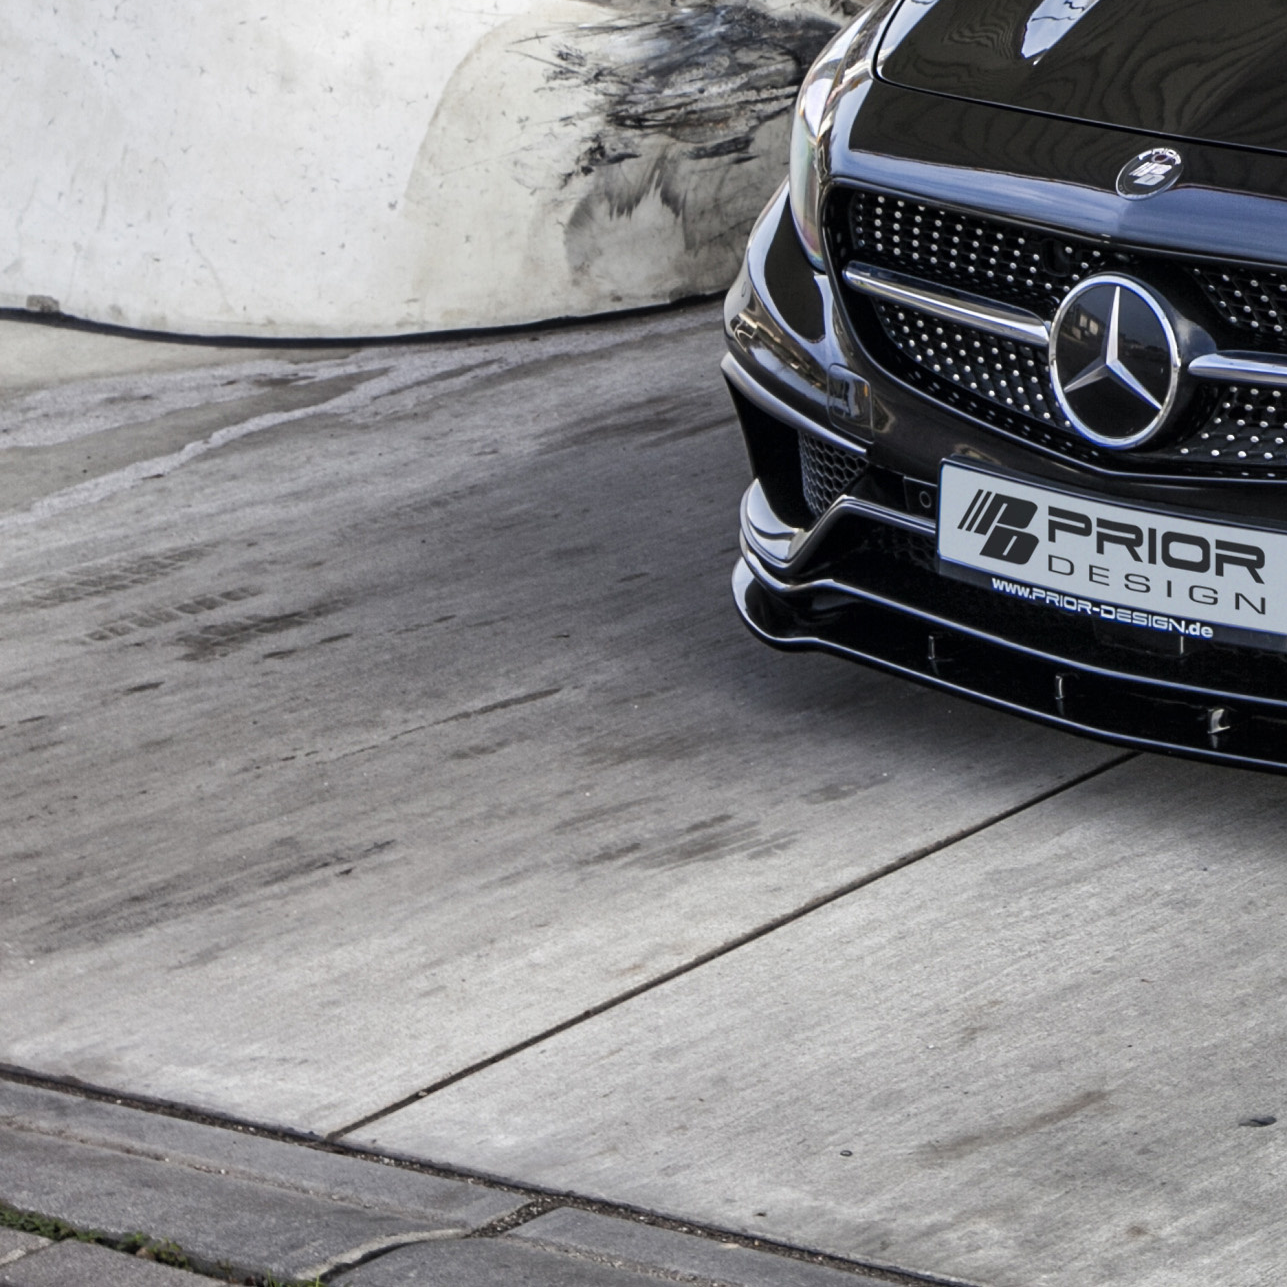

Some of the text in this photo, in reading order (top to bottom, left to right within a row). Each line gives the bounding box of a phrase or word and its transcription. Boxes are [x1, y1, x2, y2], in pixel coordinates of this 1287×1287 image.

[1048, 504, 1266, 585] PRIOR
[991, 576, 1214, 640] www.PRIOR-DESIGN.de
[1047, 553, 1267, 616] DESIGN
